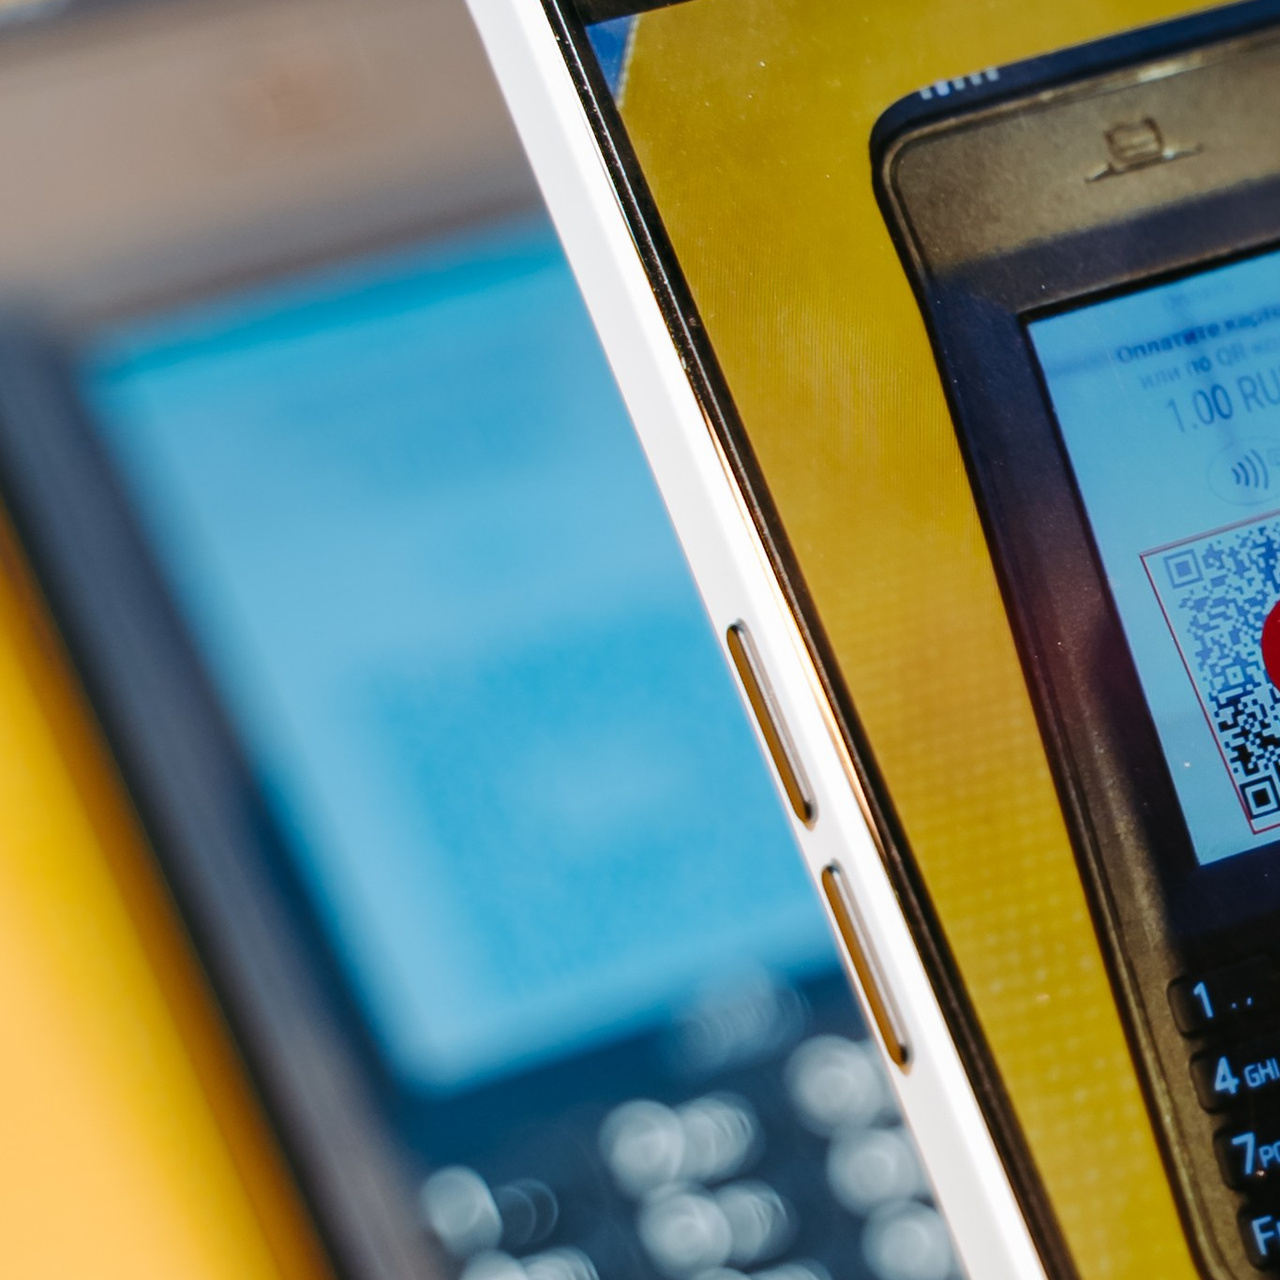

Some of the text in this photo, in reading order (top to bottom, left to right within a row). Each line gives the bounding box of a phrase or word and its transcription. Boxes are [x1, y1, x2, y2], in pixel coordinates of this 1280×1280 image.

[1167, 384, 1234, 433] 1.00
[1193, 981, 1214, 1018] 1
[1214, 1056, 1240, 1095] 4
[1231, 1132, 1256, 1176] 7
